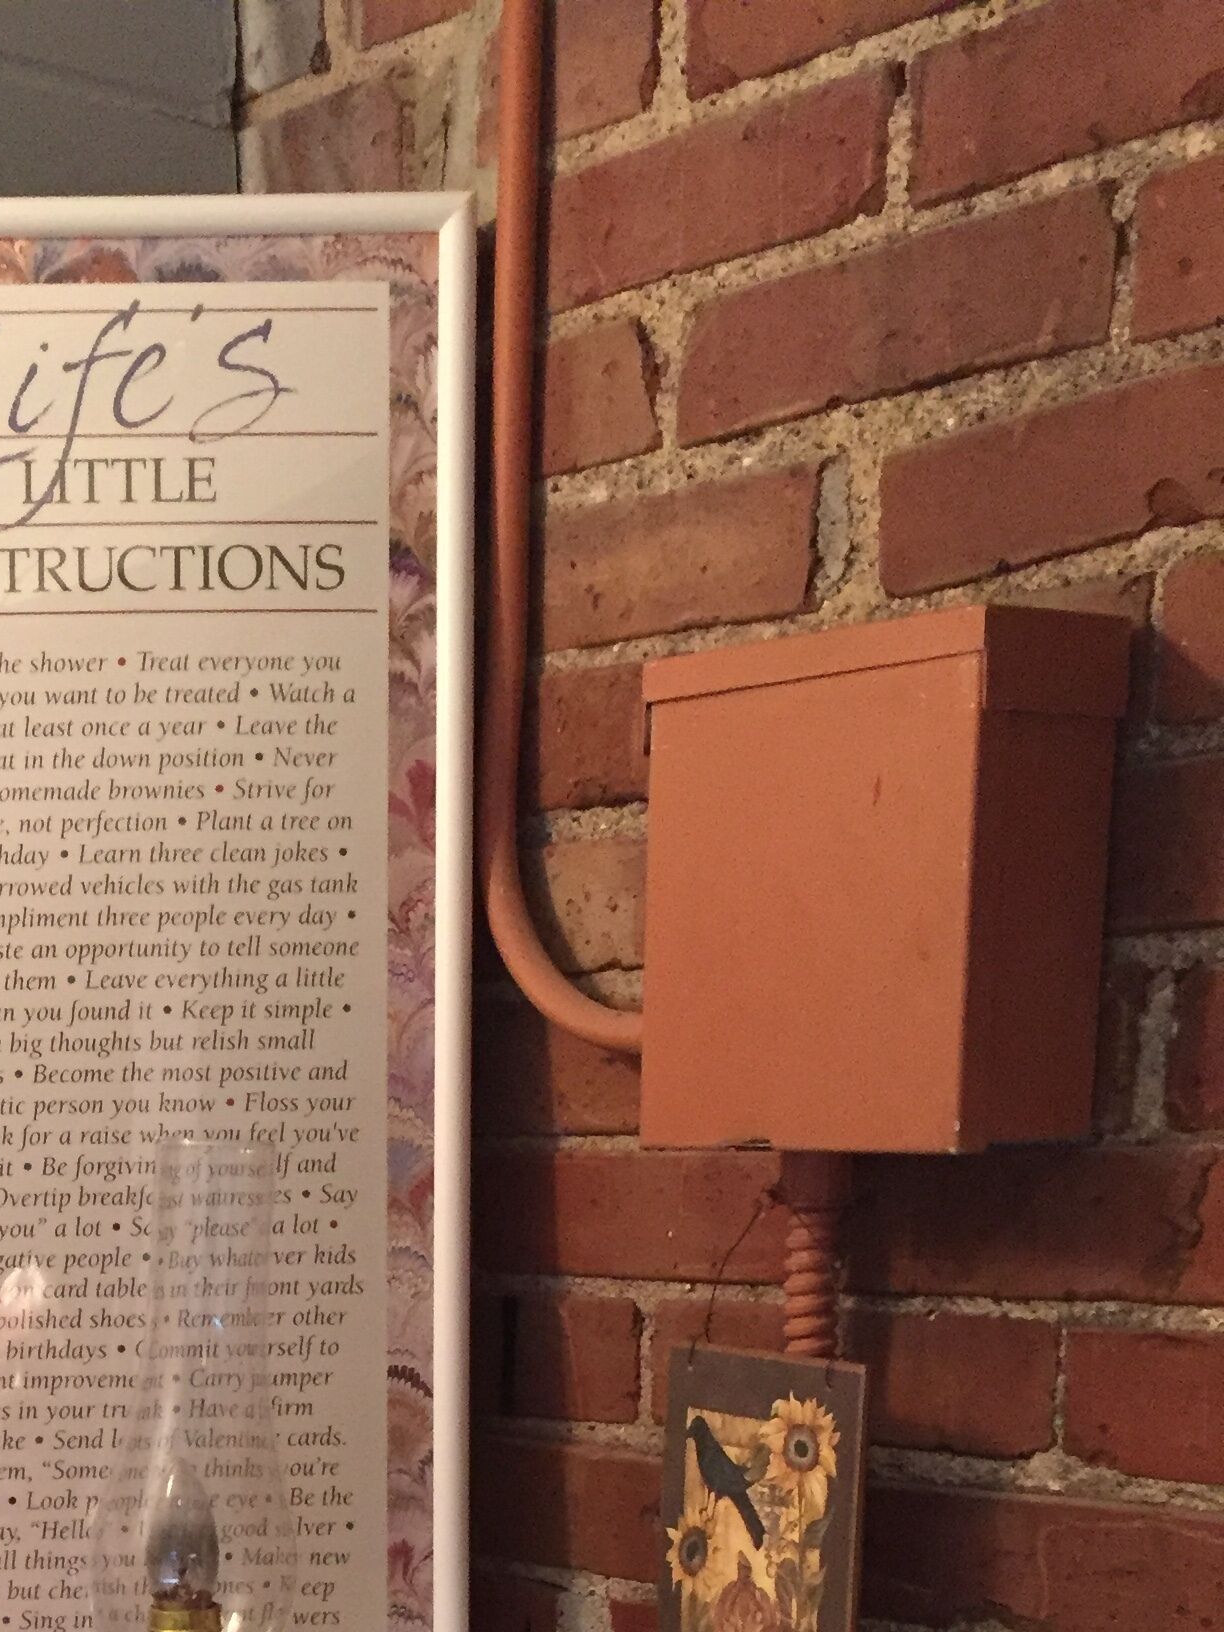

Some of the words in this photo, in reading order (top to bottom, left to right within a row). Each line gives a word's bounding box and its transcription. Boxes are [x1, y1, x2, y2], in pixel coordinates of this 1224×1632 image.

[21, 456, 218, 505] LITTLE
[29, 650, 108, 673] shower
[137, 650, 190, 672] Treat
[197, 655, 295, 676] everyone
[44, 687, 98, 706] want
[165, 680, 241, 704] treated
[268, 680, 335, 704] Watch
[24, 714, 74, 739] least
[80, 721, 131, 737] once
[158, 720, 207, 741] year
[235, 714, 298, 736] Leave
[91, 746, 151, 769] down
[157, 747, 244, 776] position
[273, 746, 337, 768] Never
[108, 778, 206, 801] brownies
[232, 778, 297, 800] Strive
[59, 809, 168, 840] perfection
[196, 808, 252, 832] Plant
[280, 813, 321, 831] tree
[78, 843, 141, 865] Learn
[149, 840, 204, 864] three
[209, 840, 267, 863] clean
[272, 840, 329, 868] jokes
[80, 872, 165, 896] vehicles
[172, 871, 220, 895] with
[310, 871, 359, 894] tank
[96, 904, 151, 927] three
[156, 903, 228, 934] people
[233, 910, 291, 932] every
[64, 937, 192, 966] opportunity
[227, 934, 261, 957] tell
[269, 941, 360, 958] someone
[3, 968, 56, 992] them
[85, 969, 148, 991] Leave
[154, 966, 269, 995] everything
[295, 965, 345, 988] little
[66, 998, 132, 1028] found
[181, 999, 235, 1027] Keep
[264, 996, 333, 1026] simple
[49, 1030, 142, 1059] thoughts
[191, 1028, 249, 1051] relish
[257, 1028, 316, 1051] small
[32, 1063, 115, 1085] Become
[161, 1065, 211, 1083] most
[218, 1064, 302, 1089] positive
[32, 1099, 104, 1122] person
[158, 1091, 216, 1113] know
[244, 1090, 299, 1113] Floss
[306, 1096, 356, 1117] your
[79, 1129, 132, 1145] raise
[249, 1121, 286, 1149] feel
[62, 1245, 133, 1275] people
[313, 1243, 357, 1265] kids
[308, 1273, 365, 1301] yards
[89, 1307, 147, 1329] shoes
[292, 1304, 346, 1327] other
[6, 1338, 108, 1366] birthdays
[18, 1405, 38, 1421] in
[46, 1404, 96, 1424] your
[52, 1427, 104, 1451] Send
[287, 1424, 347, 1447] cards.
[26, 1488, 79, 1511] Look
[290, 1487, 315, 1507] Be
[322, 1484, 354, 1507] the
[309, 1551, 351, 1566] new
[7, 1579, 41, 1601] but
